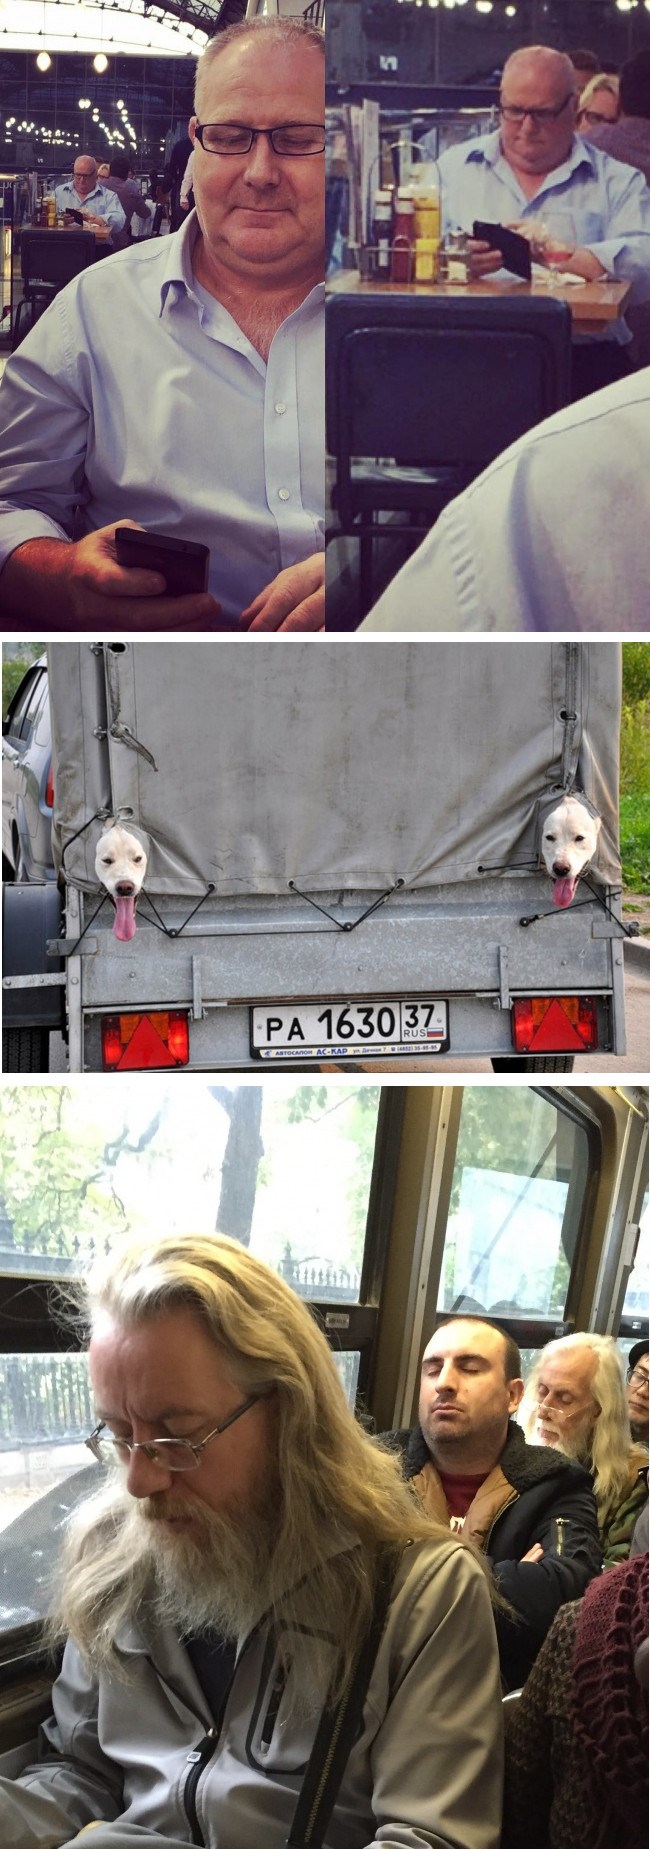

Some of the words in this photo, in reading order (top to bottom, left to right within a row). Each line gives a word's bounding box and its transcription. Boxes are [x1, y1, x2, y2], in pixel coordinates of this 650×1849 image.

[317, 1006, 396, 1040] 1630
[404, 1004, 435, 1028] 37
[403, 1028, 426, 1038] RUS
